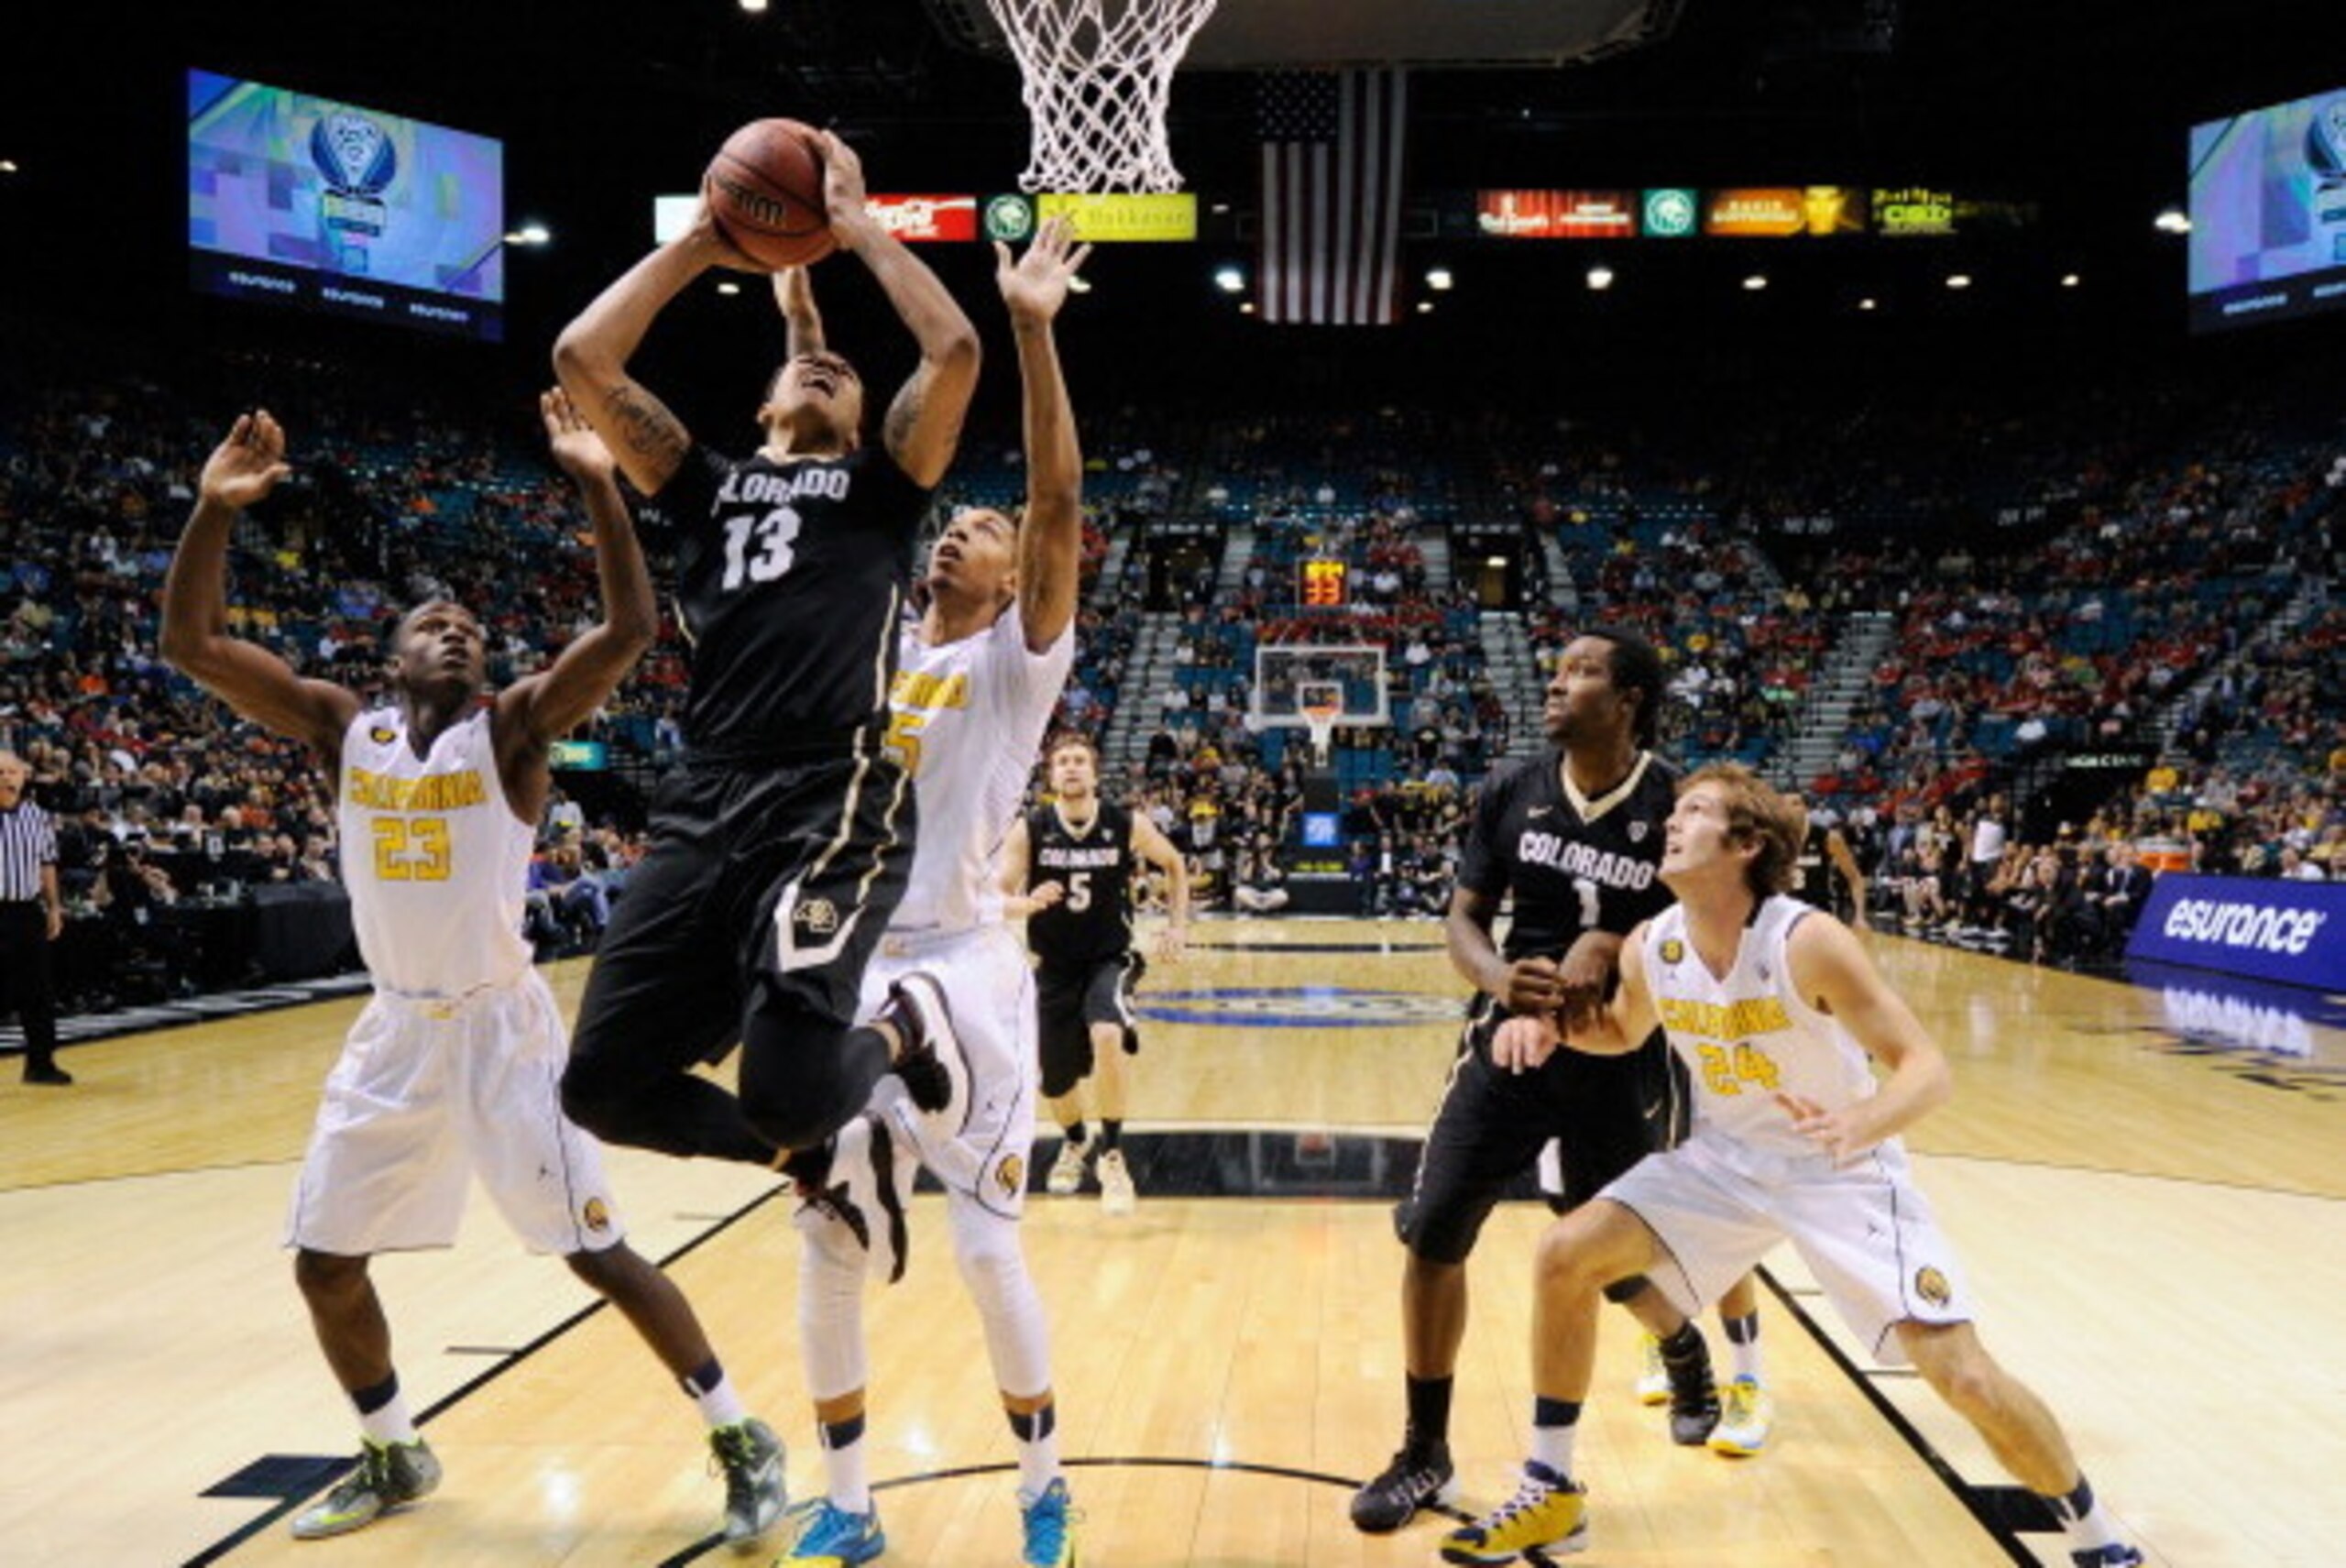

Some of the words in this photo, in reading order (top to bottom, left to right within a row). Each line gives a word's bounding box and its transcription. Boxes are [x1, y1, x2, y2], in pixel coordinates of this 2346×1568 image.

[722, 506, 802, 592] 13
[371, 816, 452, 883] 23
[1518, 828, 1656, 892] COLORADO
[1066, 872, 1091, 913] 5
[1572, 877, 1601, 928] 1
[2164, 897, 2318, 955] esurance
[1696, 1042, 1779, 1096] 24
